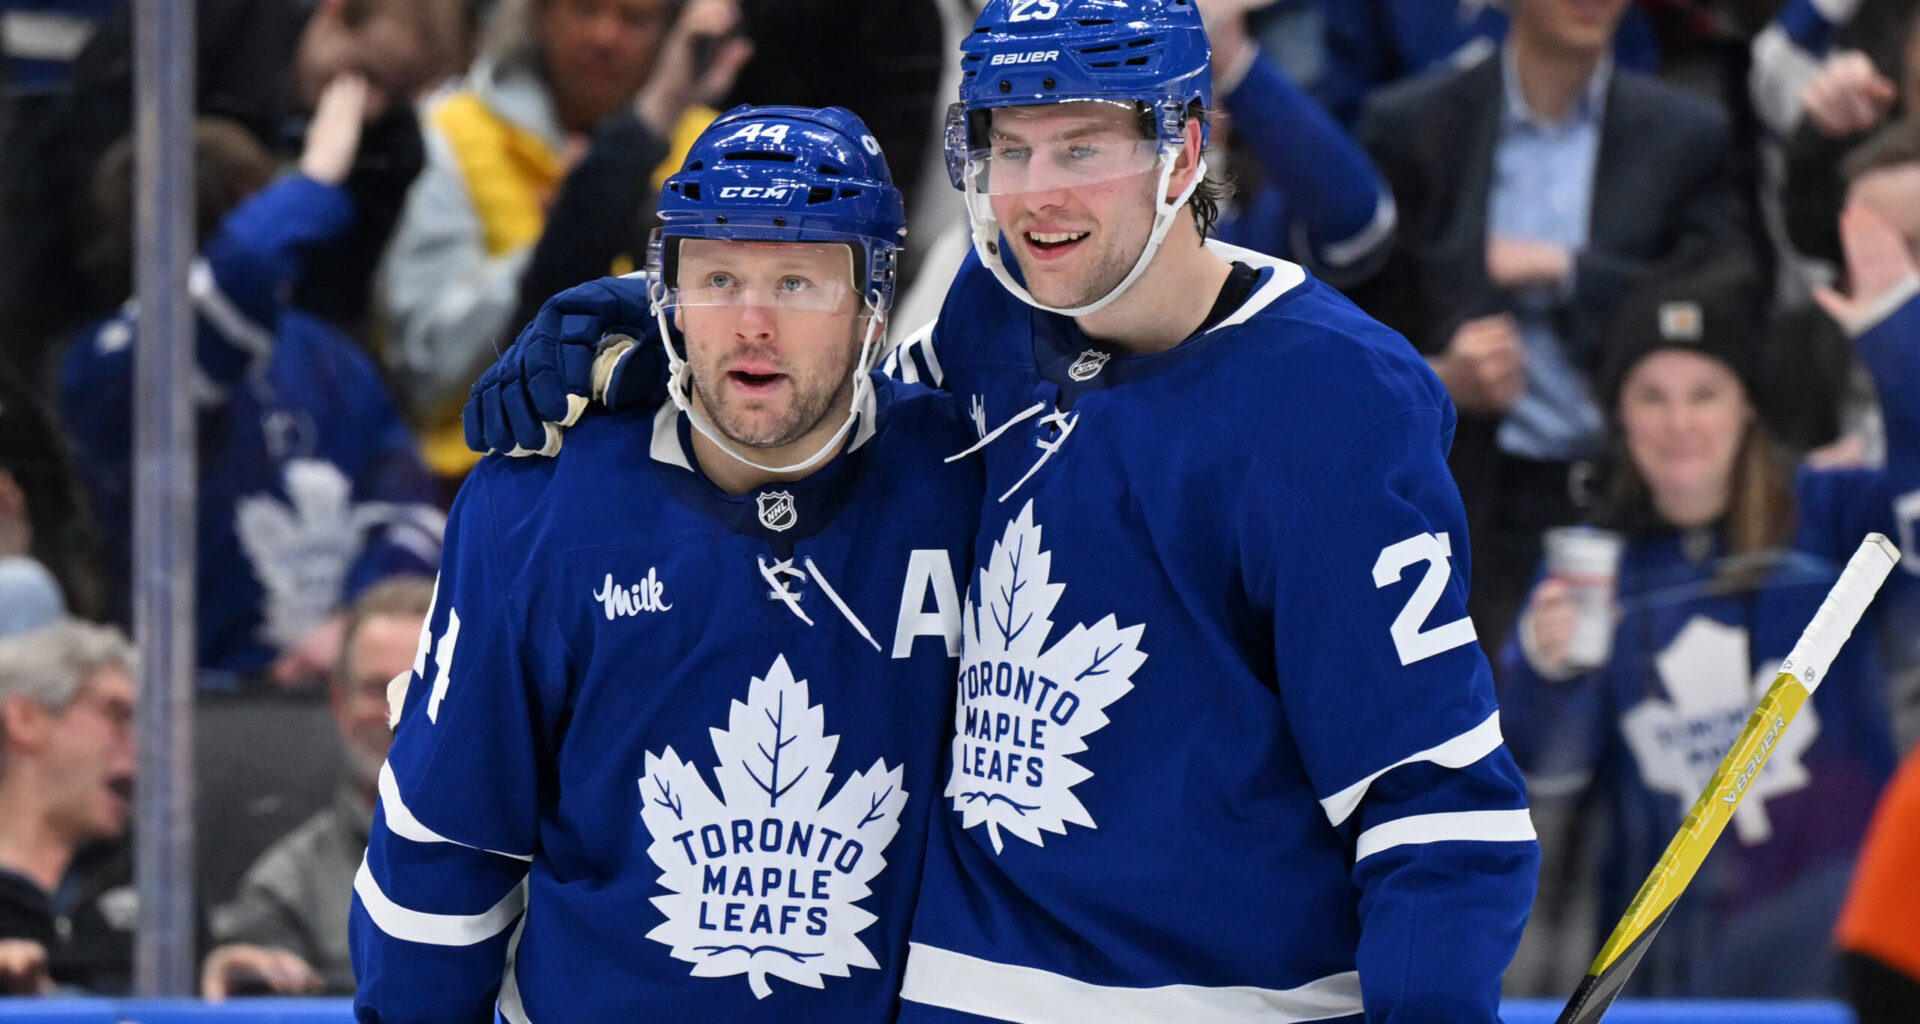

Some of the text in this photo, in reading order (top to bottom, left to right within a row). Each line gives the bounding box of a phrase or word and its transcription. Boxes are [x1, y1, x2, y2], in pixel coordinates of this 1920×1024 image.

[1008, 0, 1060, 22] 25
[990, 50, 1060, 66] BAUER
[733, 123, 791, 145] 44
[720, 187, 788, 200] CCM
[767, 502, 787, 522] NHL
[594, 567, 673, 621] Milk
[892, 549, 962, 658] A
[958, 660, 1080, 726] TORONTO
[964, 706, 1047, 750] MAPLE
[962, 743, 1044, 788] LEAFS
[1736, 715, 1785, 791] BAUER
[672, 818, 864, 875] TORONTO
[702, 864, 832, 900] MAPLE
[698, 901, 828, 936] LEAFS
